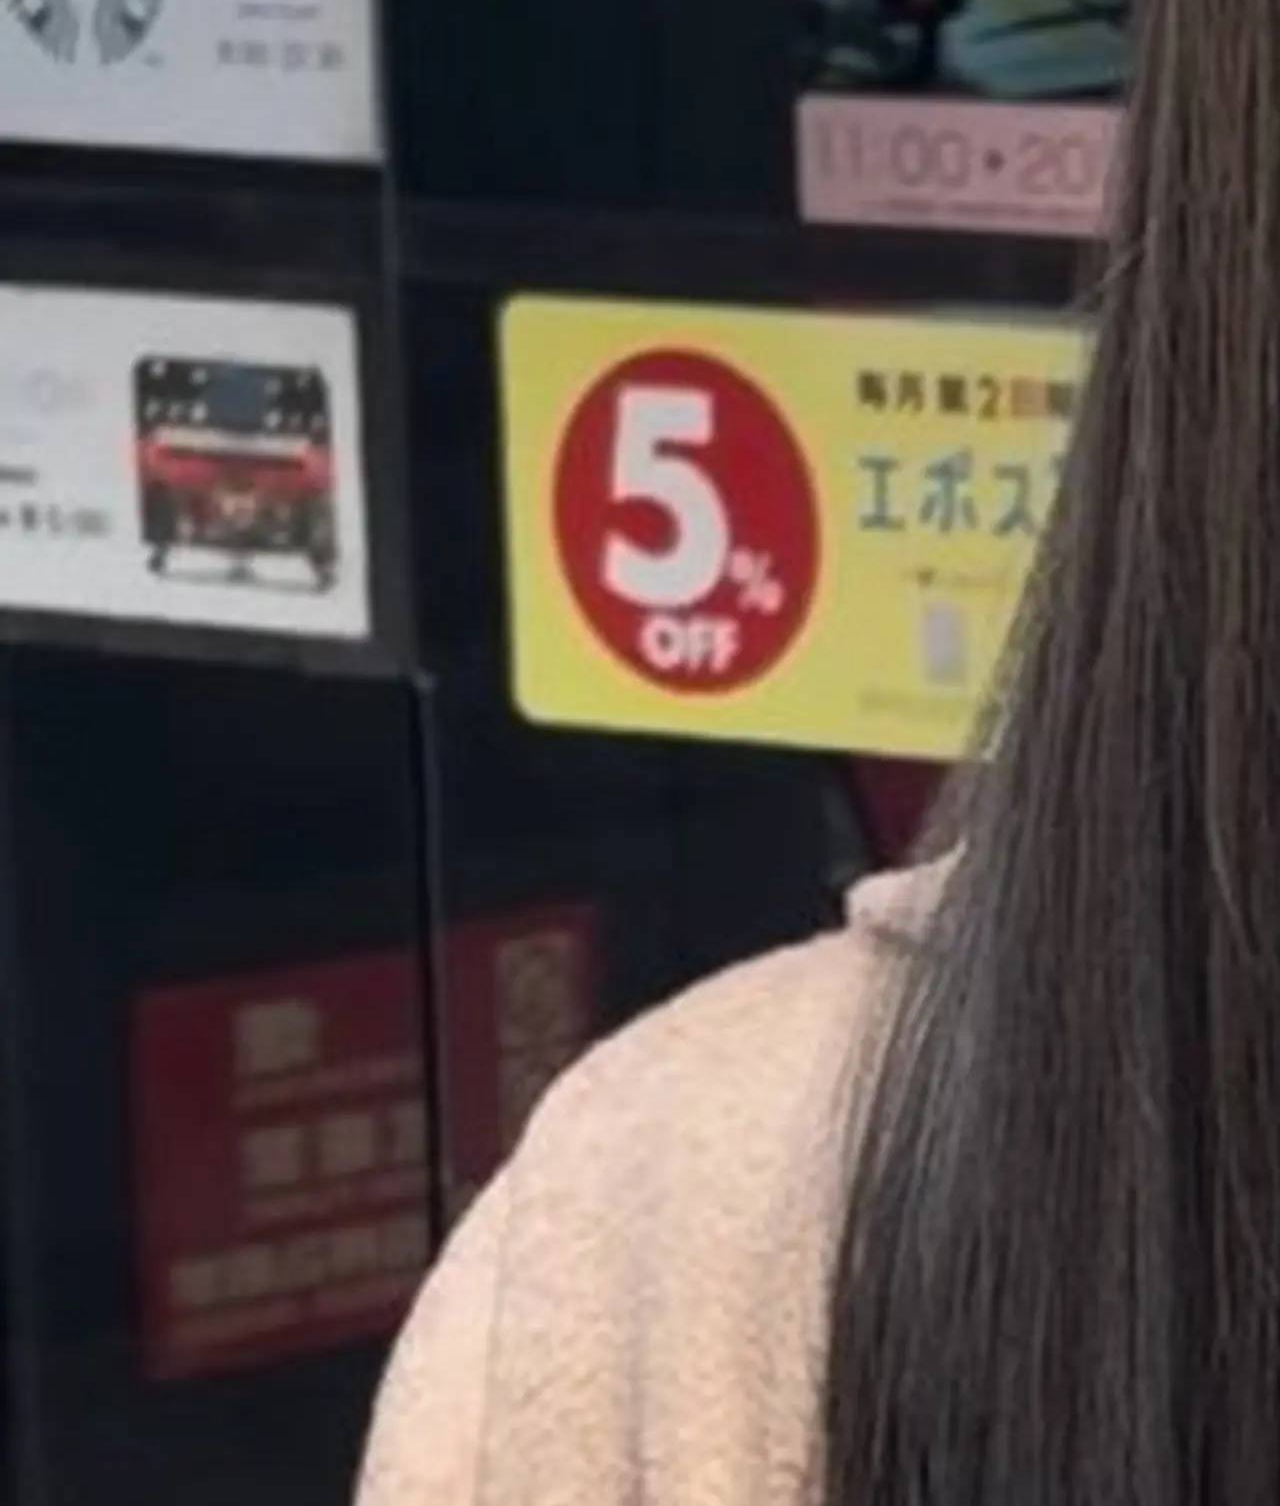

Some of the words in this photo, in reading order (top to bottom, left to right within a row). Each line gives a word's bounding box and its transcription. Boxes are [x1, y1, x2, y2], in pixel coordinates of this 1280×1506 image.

[857, 447, 1068, 538] エポス
[638, 614, 740, 673] OFF
